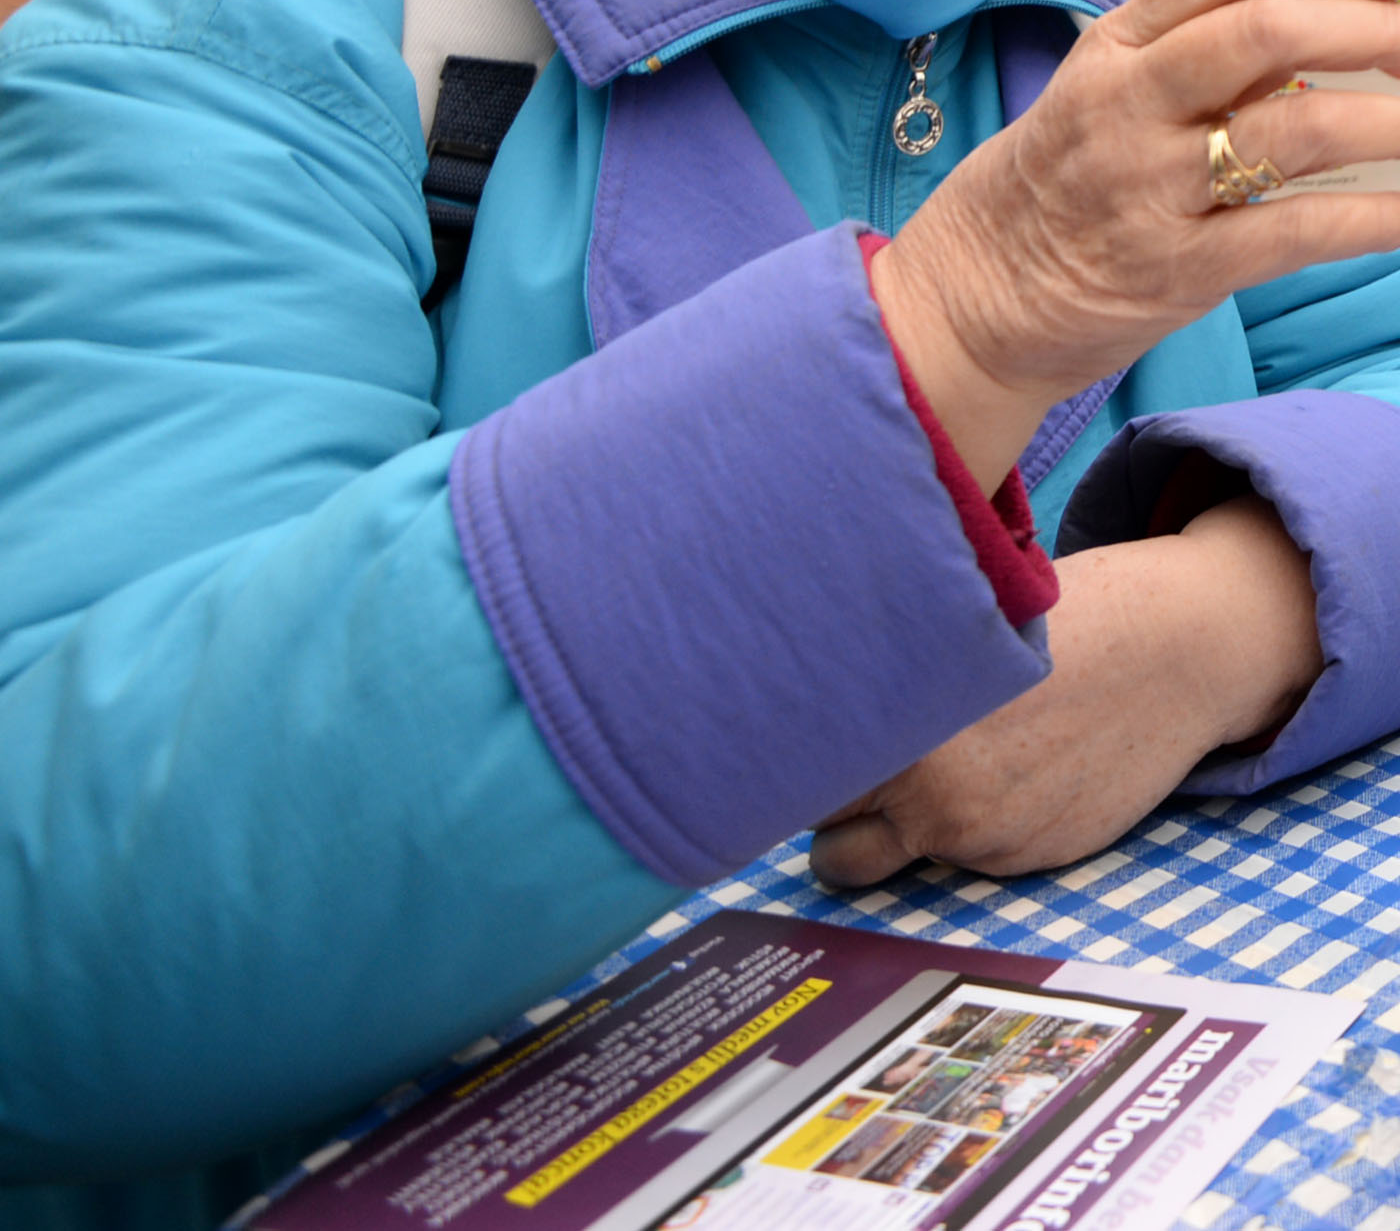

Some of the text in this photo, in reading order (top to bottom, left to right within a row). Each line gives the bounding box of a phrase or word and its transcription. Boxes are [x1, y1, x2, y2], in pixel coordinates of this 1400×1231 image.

[770, 983, 819, 1013] Nov
[702, 1017, 774, 1063] medij
[1194, 1052, 1281, 1123] Vsak
[1134, 1123, 1209, 1188] dan
